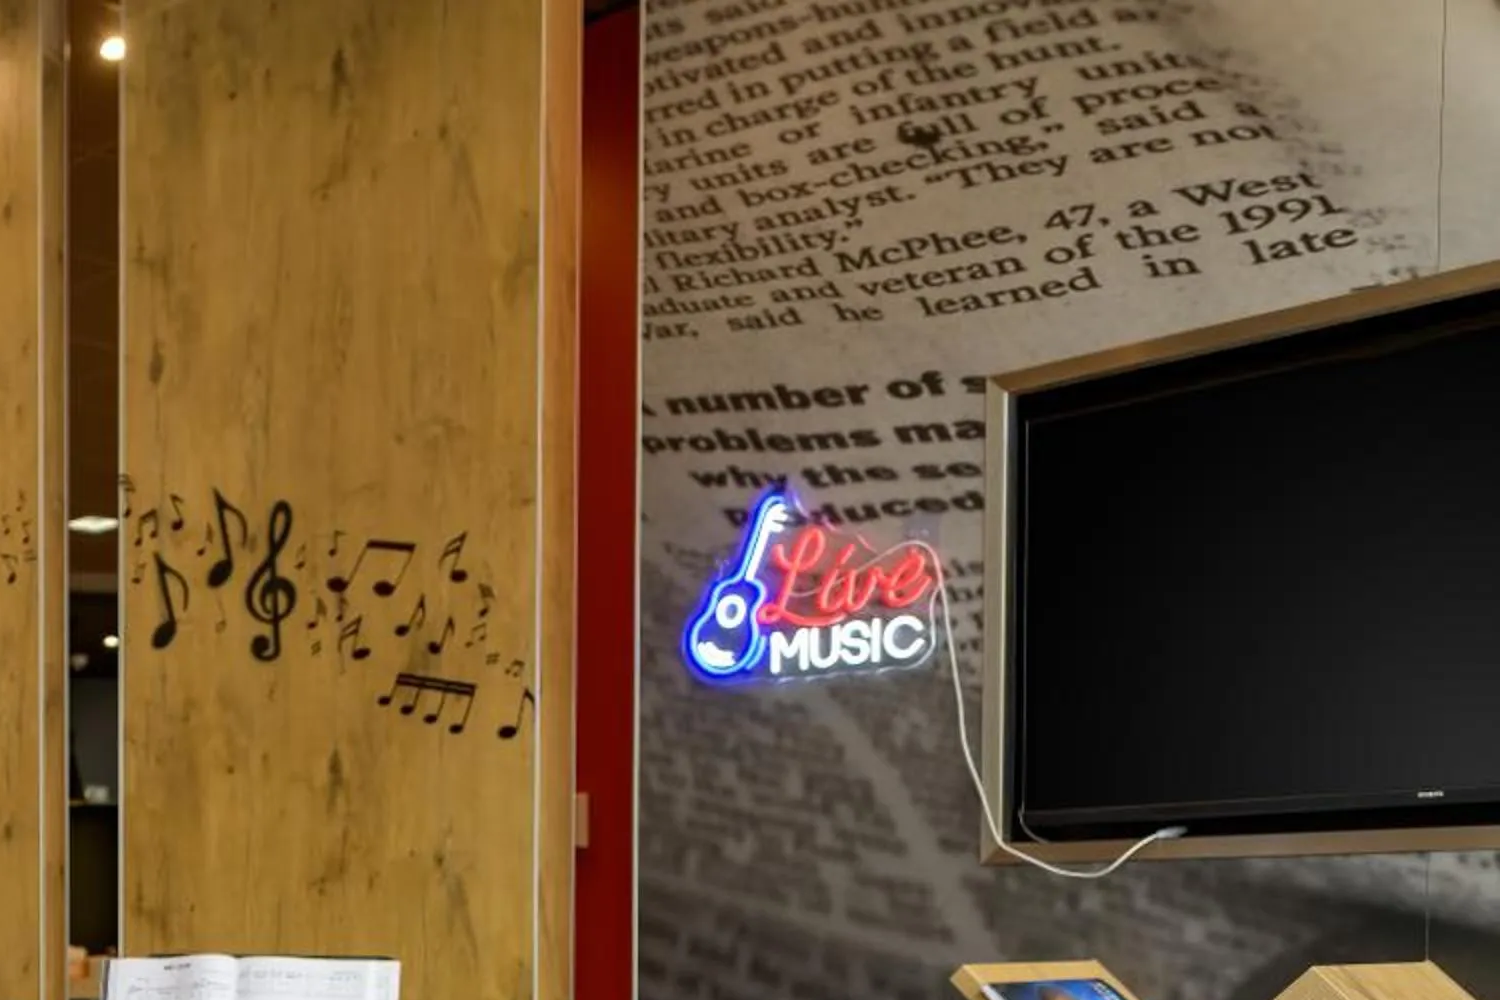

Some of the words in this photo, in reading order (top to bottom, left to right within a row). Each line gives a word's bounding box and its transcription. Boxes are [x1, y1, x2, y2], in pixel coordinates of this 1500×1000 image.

[727, 79, 772, 104] in
[778, 40, 941, 96] putting
[947, 35, 974, 51] a
[985, 7, 1099, 44] field
[802, 18, 884, 55] and
[657, 127, 698, 148] in
[705, 89, 840, 138] charge
[851, 69, 897, 96] of
[904, 61, 978, 86] the
[985, 36, 1122, 71] hunt.
[777, 121, 821, 145] or
[849, 75, 1039, 126] infantry
[655, 195, 724, 223] and
[1097, 100, 1208, 136] said
[689, 158, 789, 192] units
[806, 136, 878, 166] are
[897, 112, 981, 148] full
[1000, 95, 1050, 126] of
[754, 183, 917, 232] analyst.
[1090, 138, 1175, 166] are
[669, 256, 822, 293] Richard
[833, 223, 1027, 273] McPhee,
[1044, 203, 1110, 231] 47,
[1128, 199, 1160, 217] a
[1171, 171, 1324, 207] West
[727, 306, 804, 332] said
[832, 303, 885, 322] he
[915, 266, 1102, 317] learned
[1142, 254, 1202, 279] in
[1243, 226, 1360, 265] late
[769, 281, 844, 303] and
[858, 256, 1025, 297] veteran
[1044, 234, 1097, 264] of
[1116, 222, 1201, 250] the
[1218, 194, 1345, 235] 1991
[665, 383, 870, 416] number
[887, 370, 946, 400] of
[802, 463, 898, 489] the
[758, 526, 933, 627] Live
[769, 614, 927, 675] MUSIC
